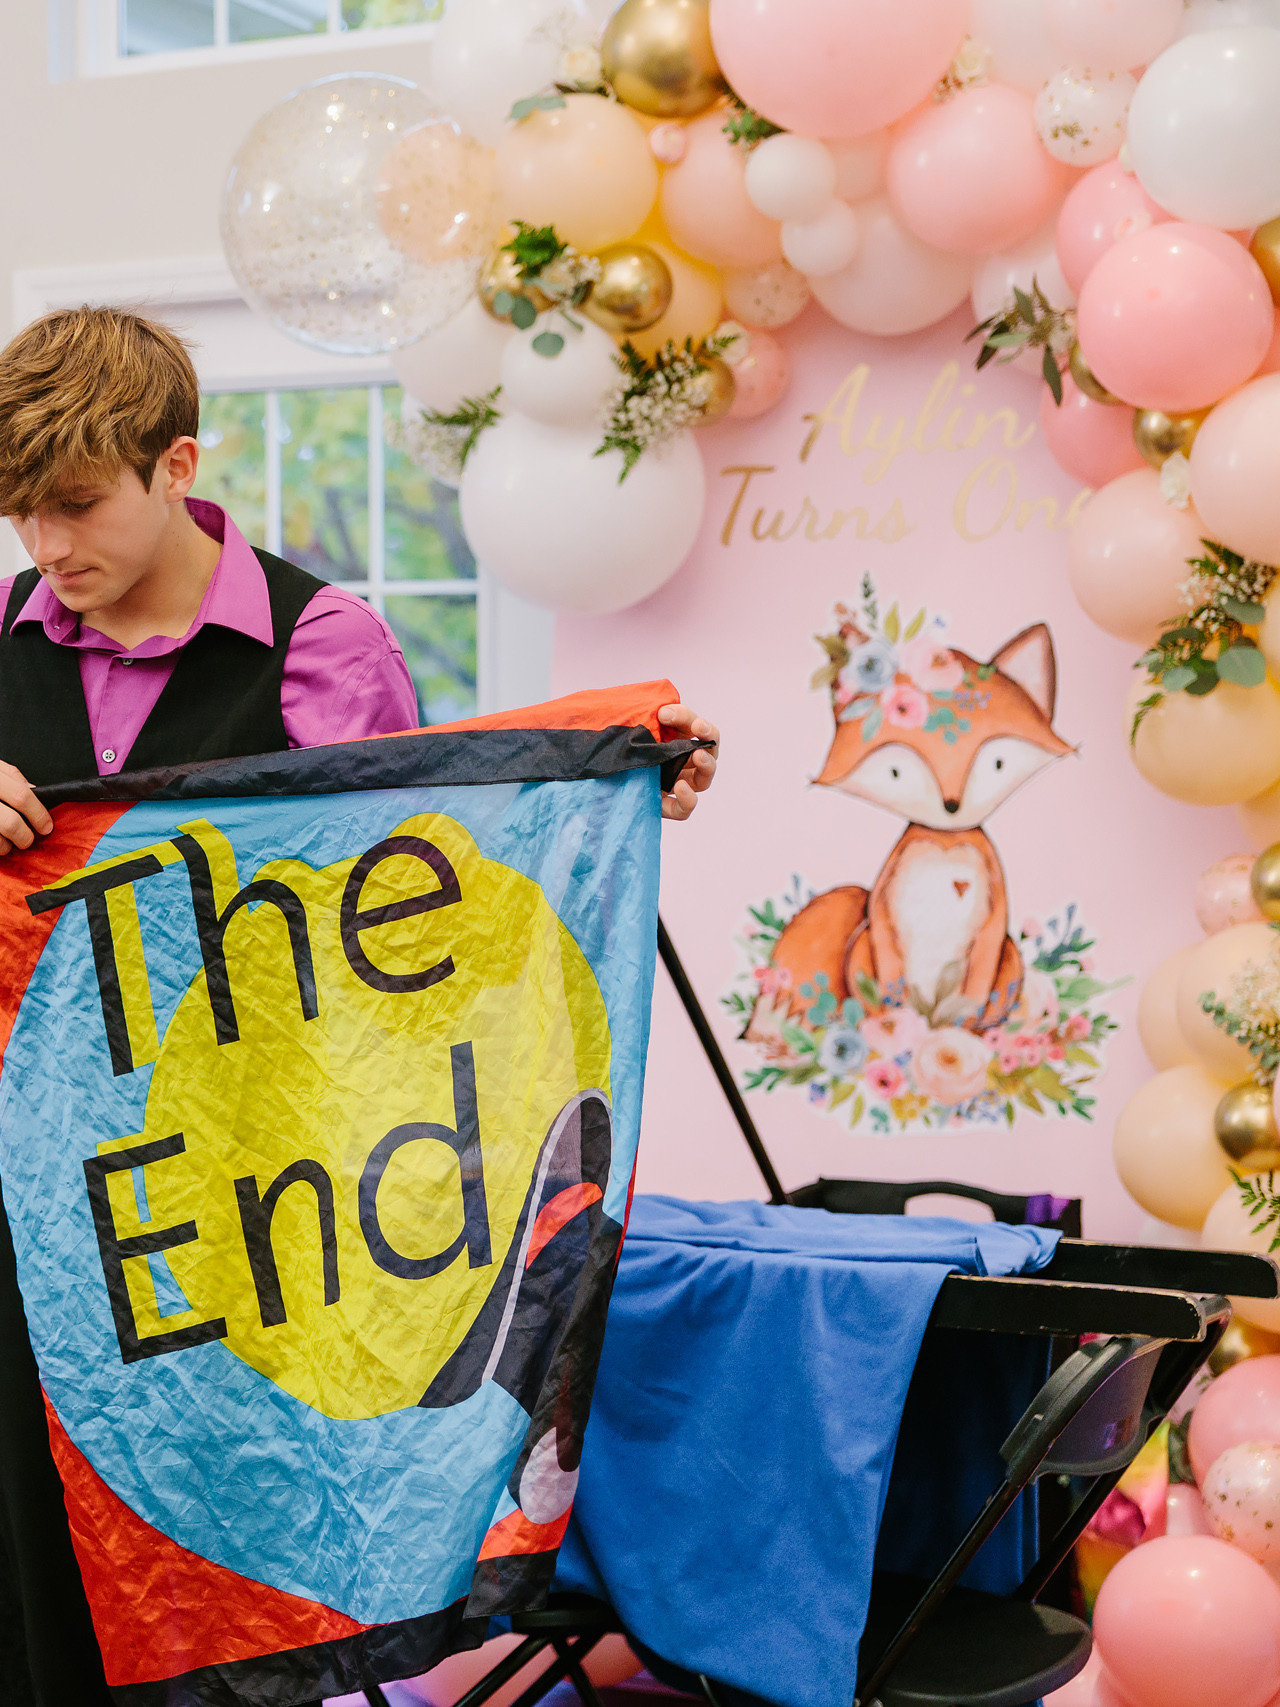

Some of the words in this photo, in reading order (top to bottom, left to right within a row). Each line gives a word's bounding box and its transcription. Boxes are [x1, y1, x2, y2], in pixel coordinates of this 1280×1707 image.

[720, 464, 918, 547] Turns
[799, 360, 1037, 486] Aylin
[25, 833, 463, 1077] The
[82, 1040, 494, 1365] End
